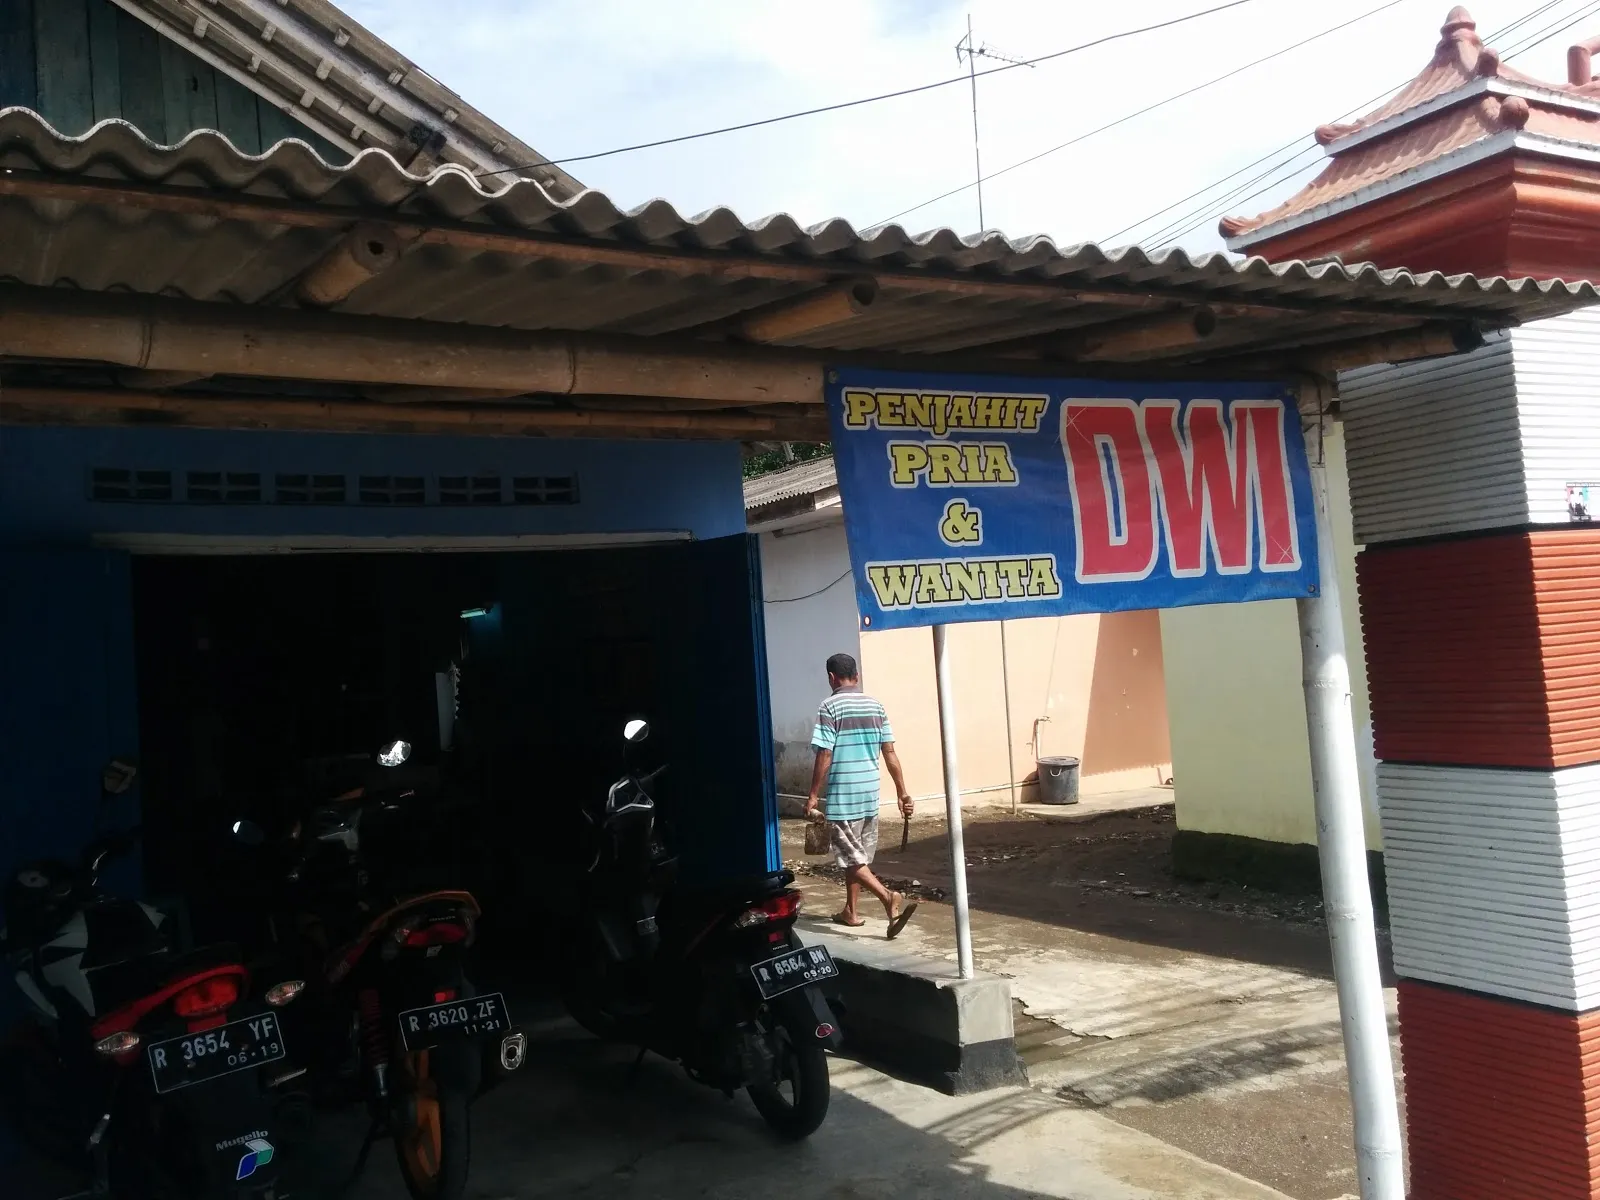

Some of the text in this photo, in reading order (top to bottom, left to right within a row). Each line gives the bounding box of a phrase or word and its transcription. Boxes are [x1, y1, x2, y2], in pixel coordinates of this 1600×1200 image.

[842, 388, 1049, 438] PENJAHIT
[888, 441, 1020, 488] PRIA
[1059, 398, 1302, 584] DWI
[938, 498, 983, 547] &
[865, 554, 1064, 612] WANITA
[408, 1000, 496, 1032] R 3620 ZF
[154, 1017, 274, 1069] R 3654 YF
[215, 1129, 269, 1152] Mugello
